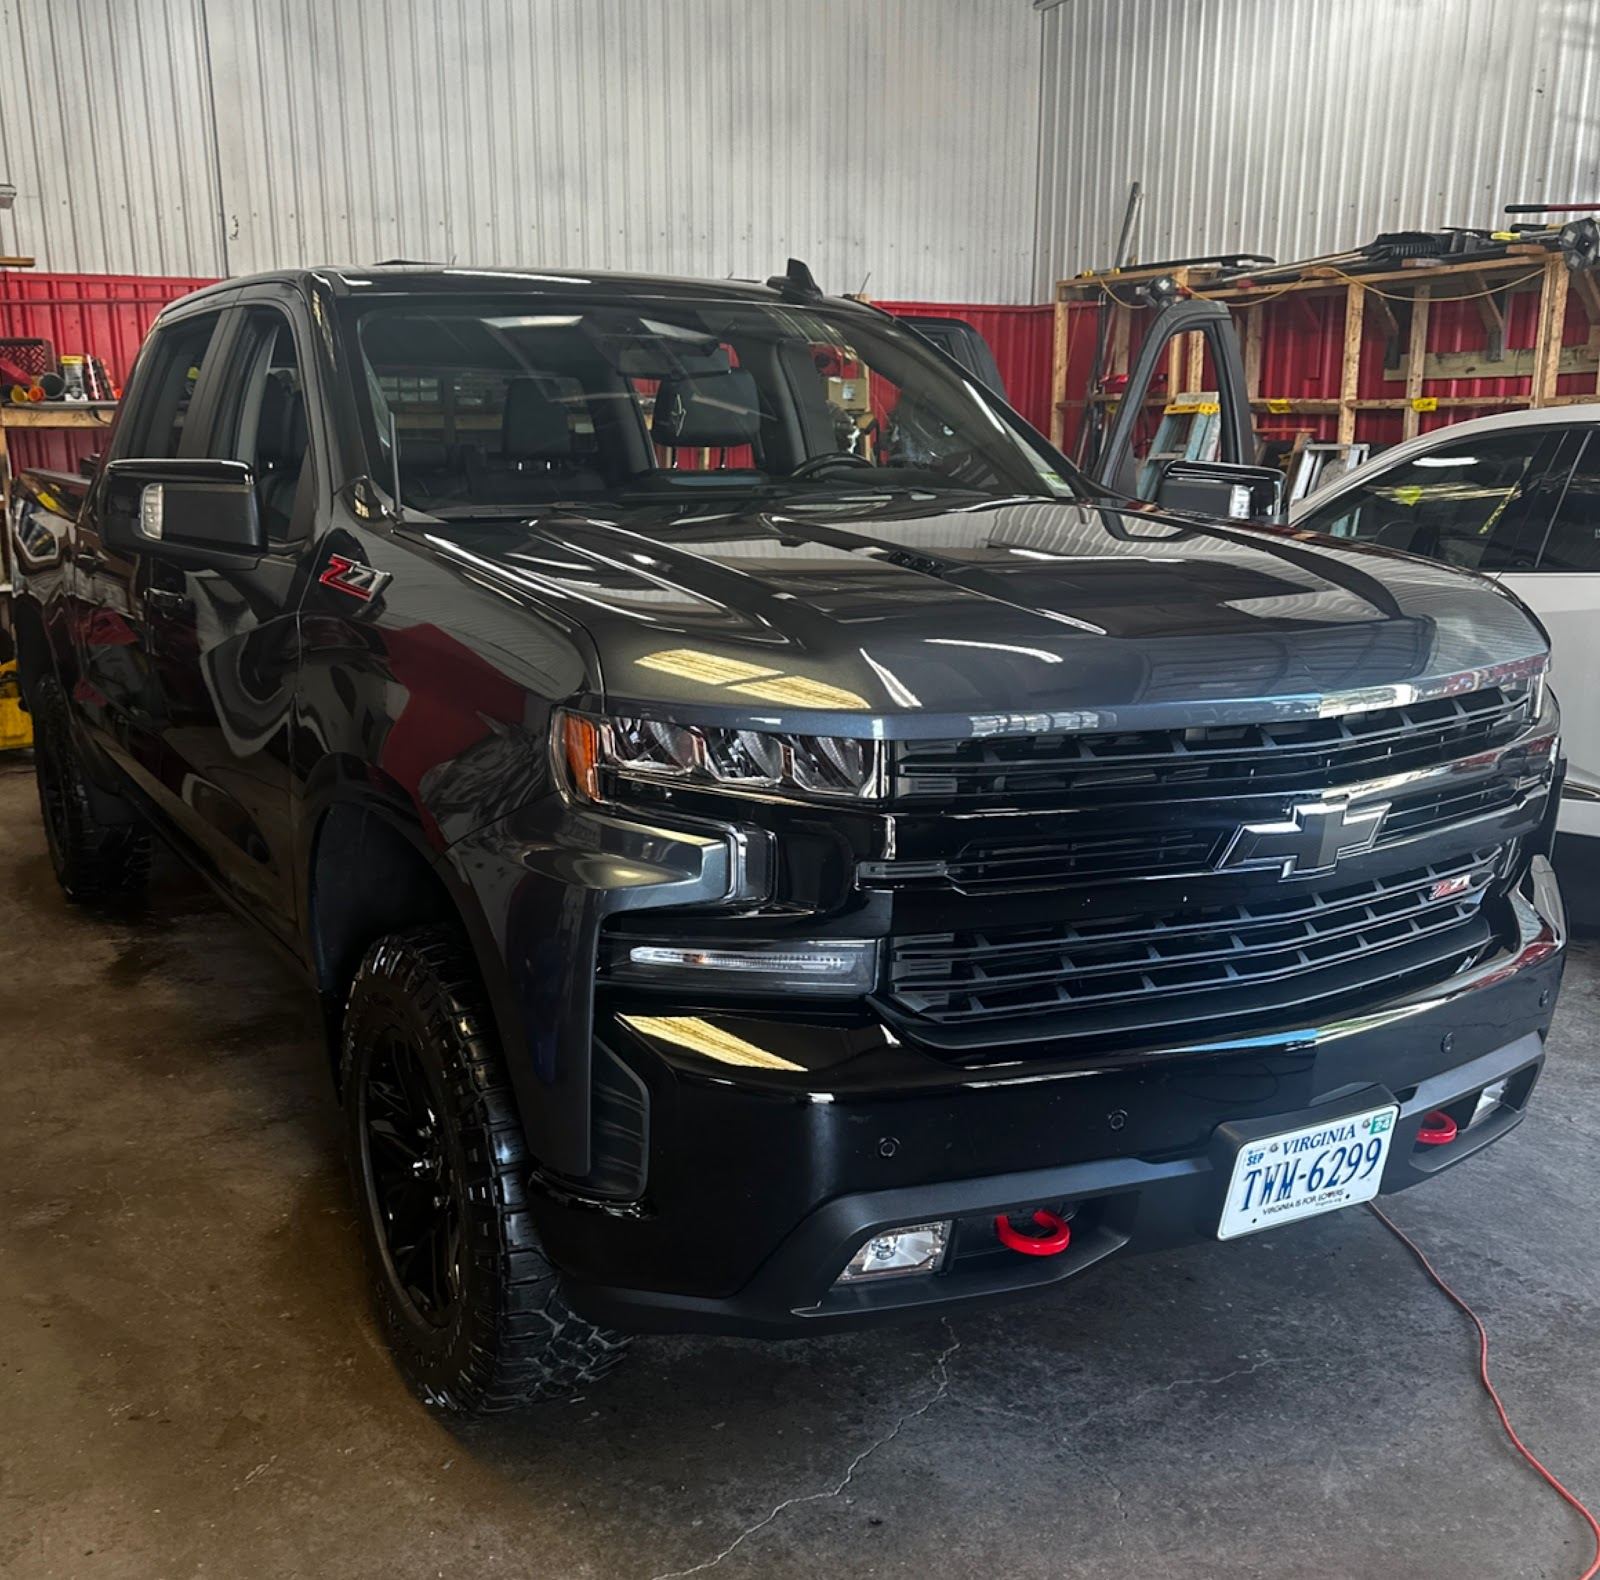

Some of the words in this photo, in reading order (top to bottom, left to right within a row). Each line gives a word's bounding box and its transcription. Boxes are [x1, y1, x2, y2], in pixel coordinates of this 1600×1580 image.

[319, 553, 393, 602] Z71
[1429, 874, 1471, 901] Z71
[1283, 1124, 1356, 1156] VIRGINIA
[1246, 1152, 1264, 1166] SEP
[1240, 1137, 1382, 1212] TWM-6299
[1263, 1202, 1294, 1215] VIRGINIA
[1303, 1195, 1317, 1204] FOR
